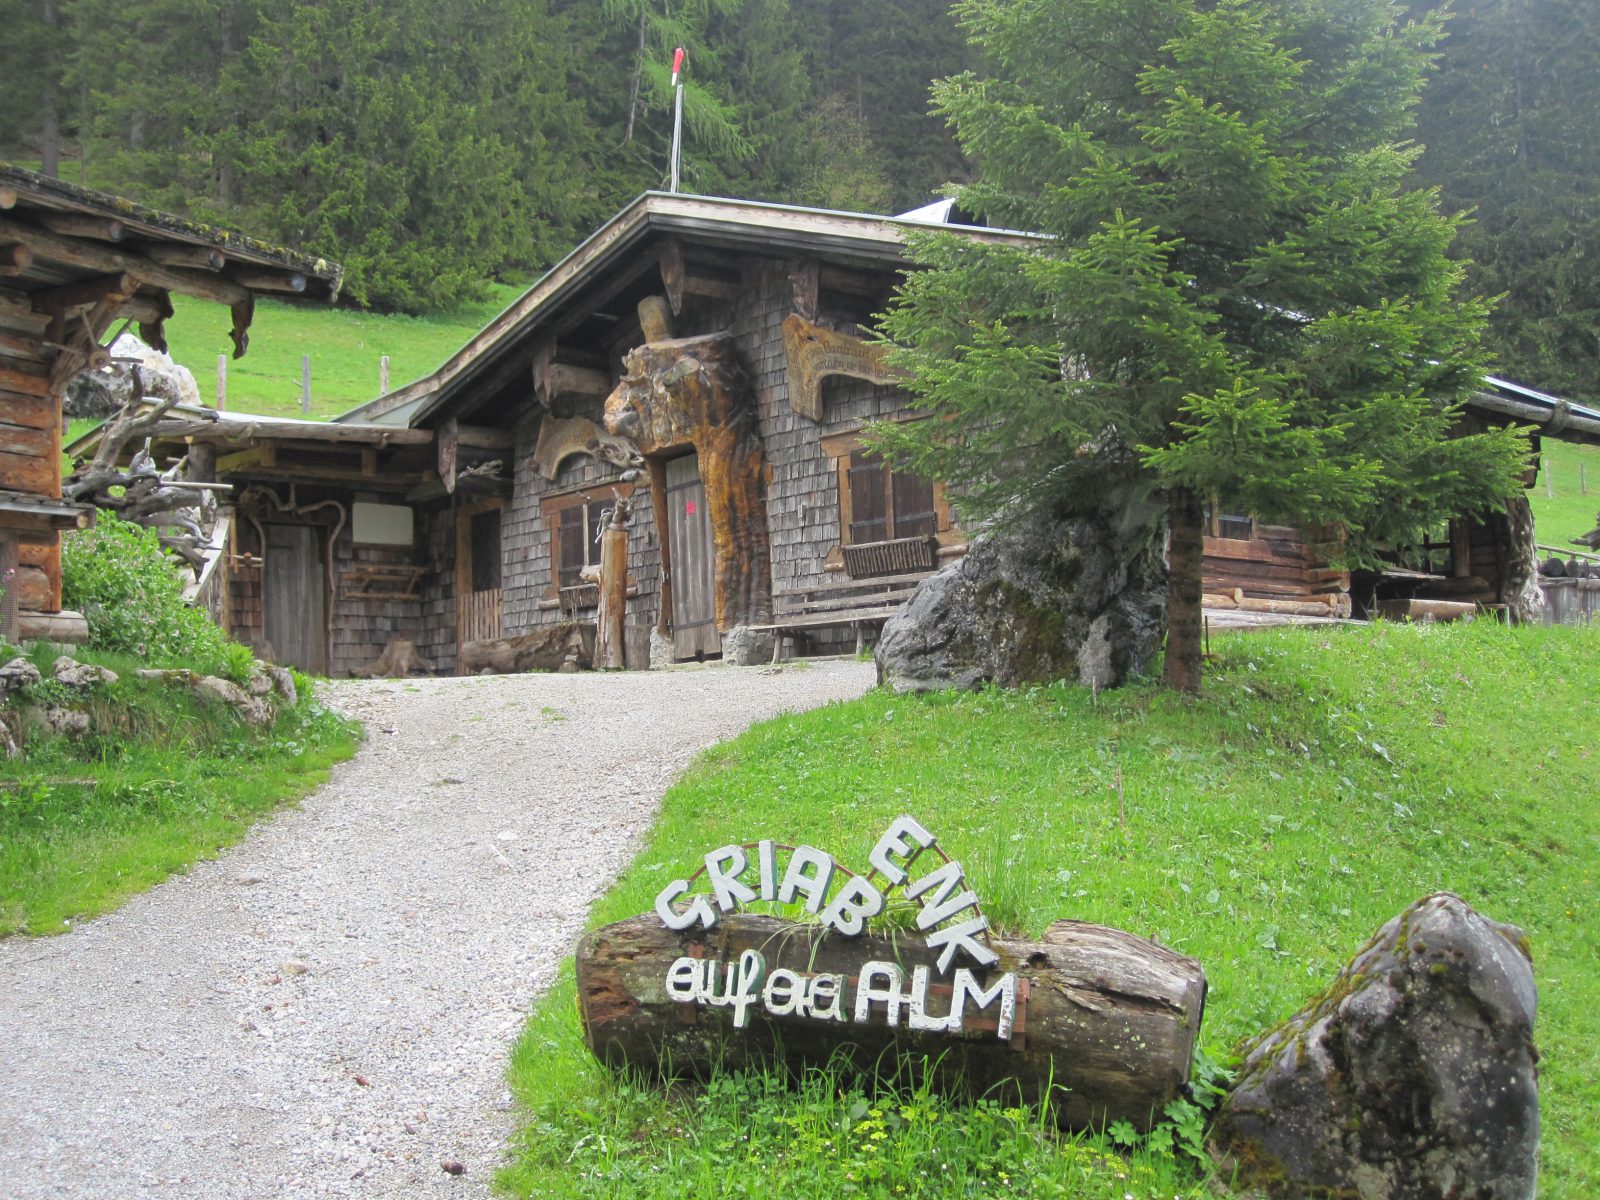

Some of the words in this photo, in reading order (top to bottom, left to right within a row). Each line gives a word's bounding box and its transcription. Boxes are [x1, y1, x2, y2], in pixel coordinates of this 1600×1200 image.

[868, 813, 1000, 977] ENK
[665, 948, 765, 1028] auf
[854, 960, 1016, 1040] ALM
